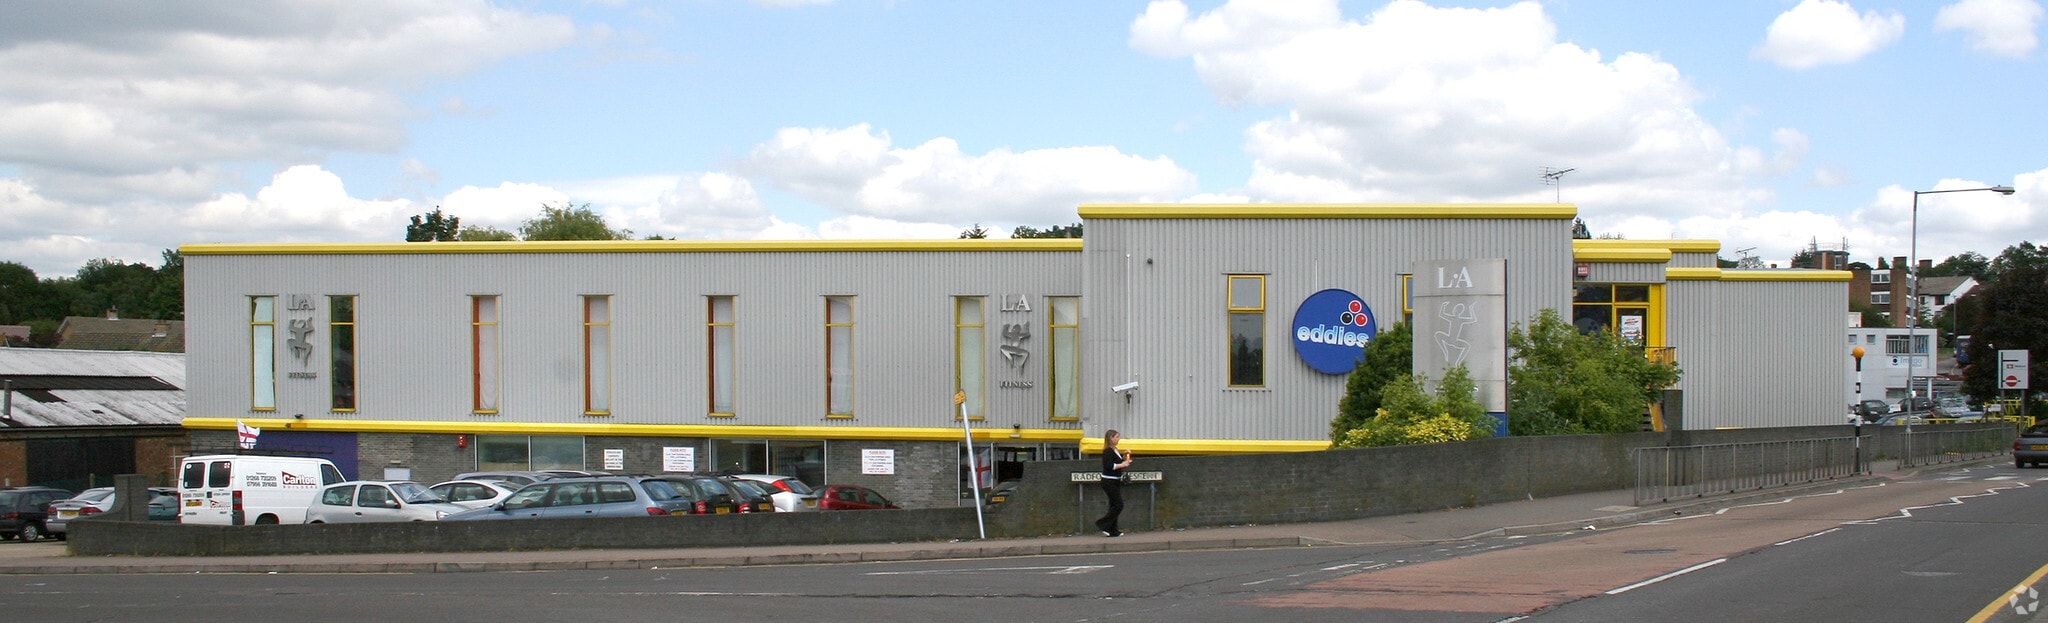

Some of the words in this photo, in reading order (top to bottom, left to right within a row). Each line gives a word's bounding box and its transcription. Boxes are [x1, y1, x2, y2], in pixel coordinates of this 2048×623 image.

[1297, 323, 1370, 348] eddies
[1000, 381, 1033, 389] FITNESS
[284, 475, 316, 485] Carlton
